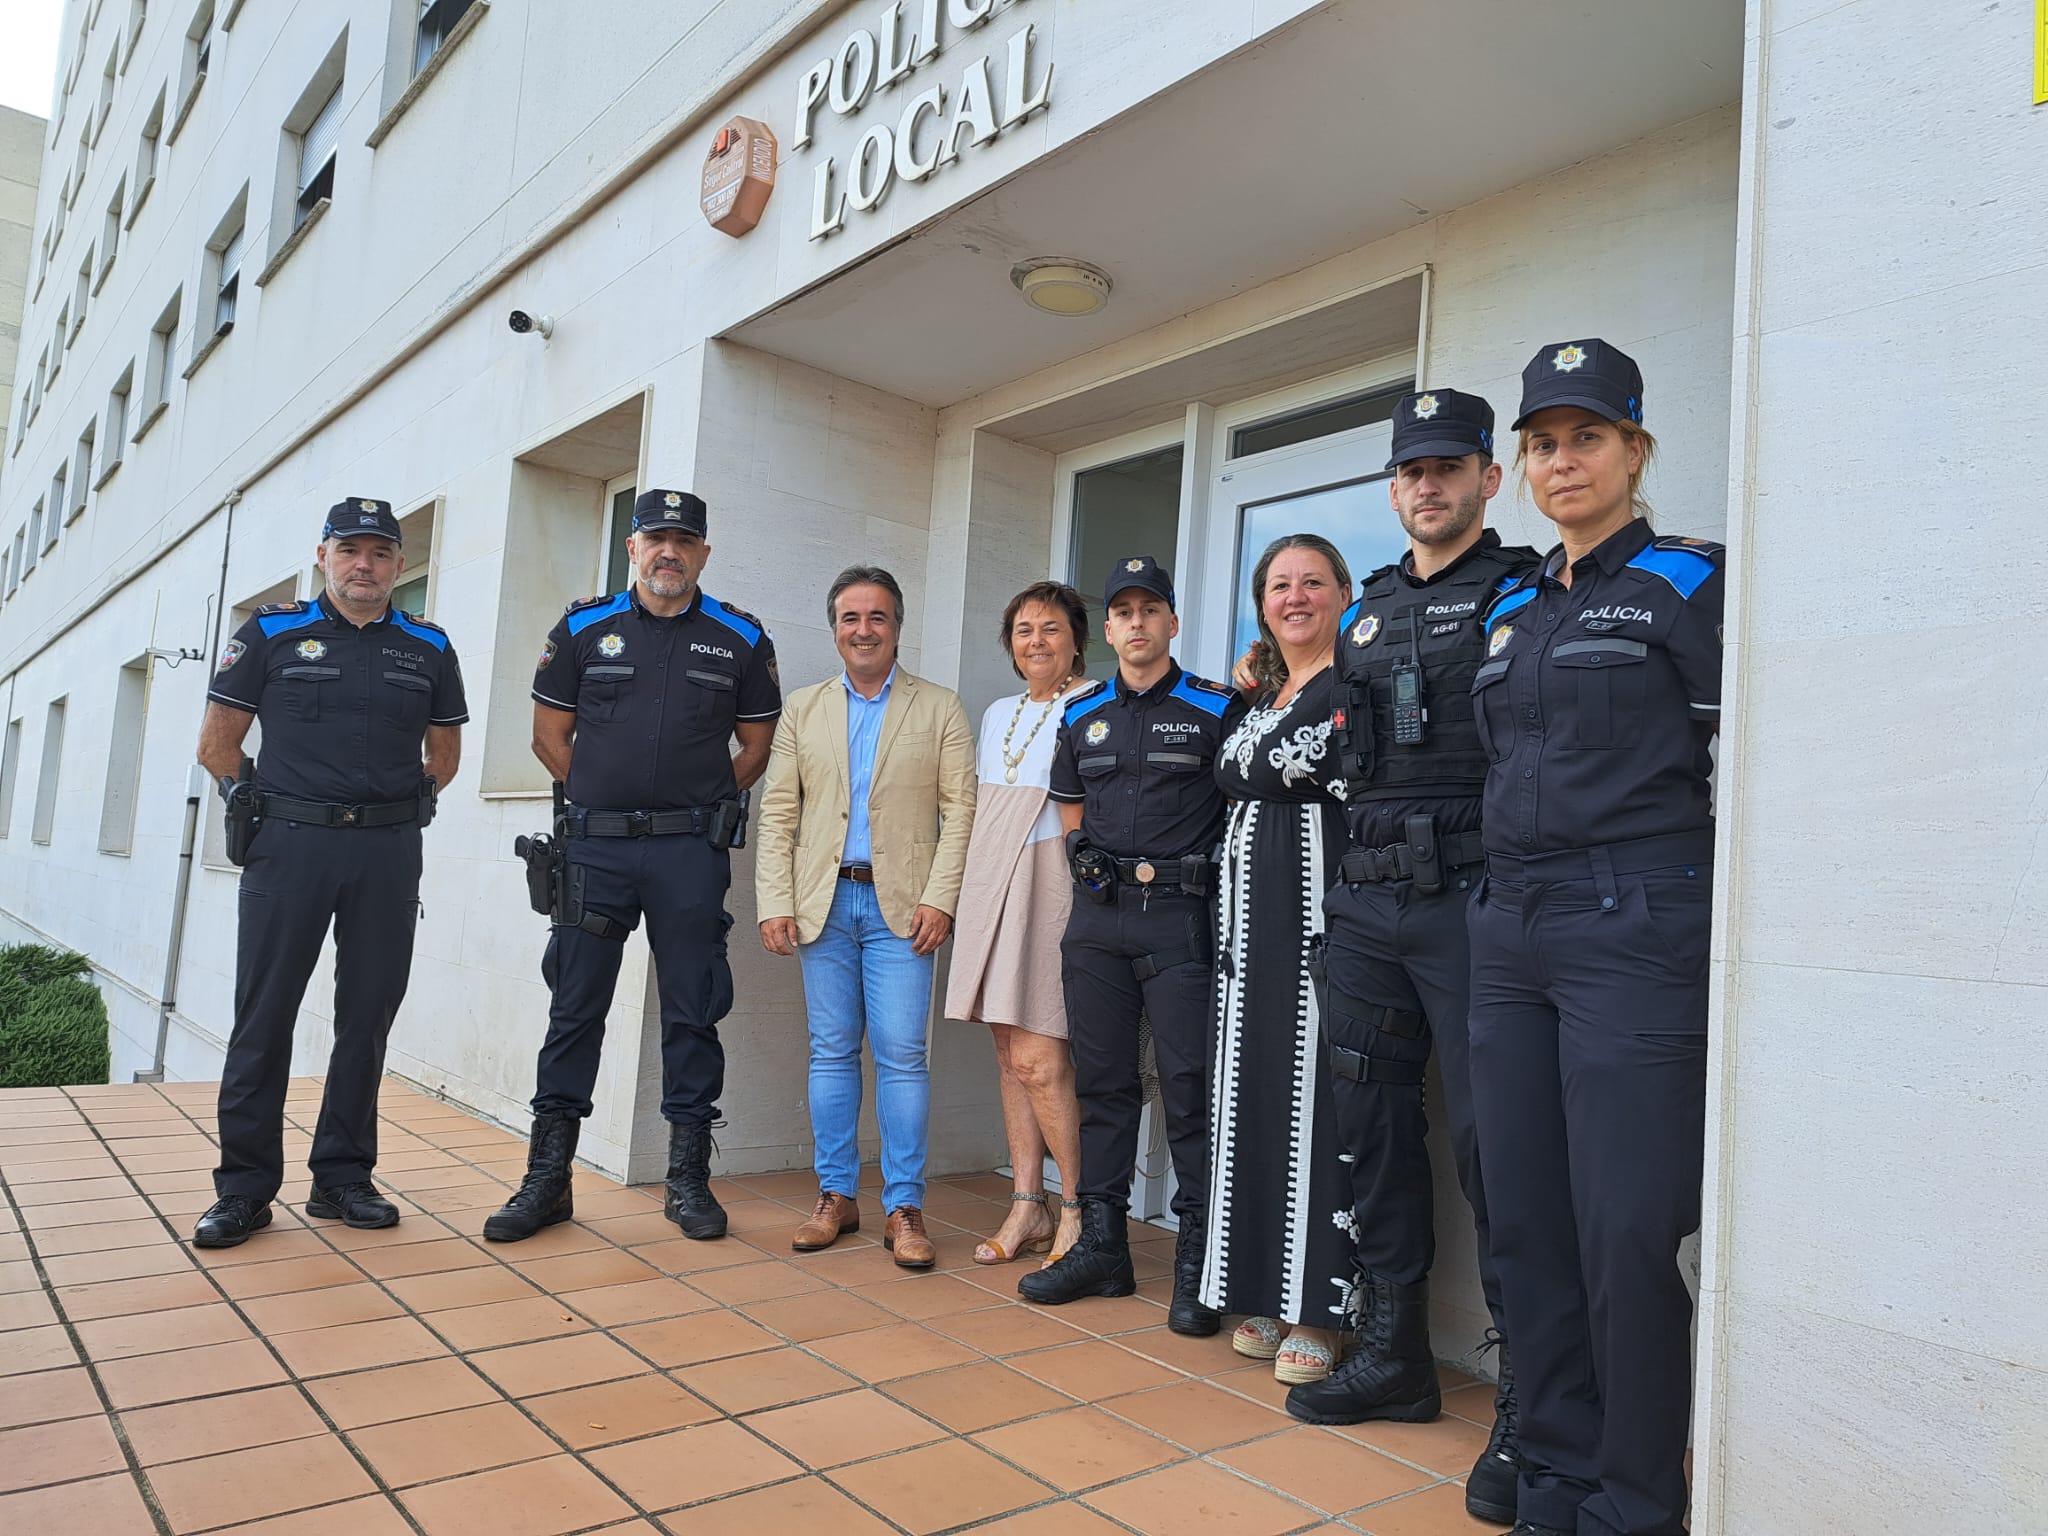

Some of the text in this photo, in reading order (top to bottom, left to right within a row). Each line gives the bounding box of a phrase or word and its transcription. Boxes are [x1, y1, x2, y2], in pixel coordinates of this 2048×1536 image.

[793, 0, 1010, 151] POLI
[809, 24, 1053, 241] LOCAL
[1425, 602, 1475, 615] POLICIA
[382, 647, 425, 663] POLICIA
[690, 643, 733, 659] POLICIA
[1152, 723, 1201, 734] POLICIA
